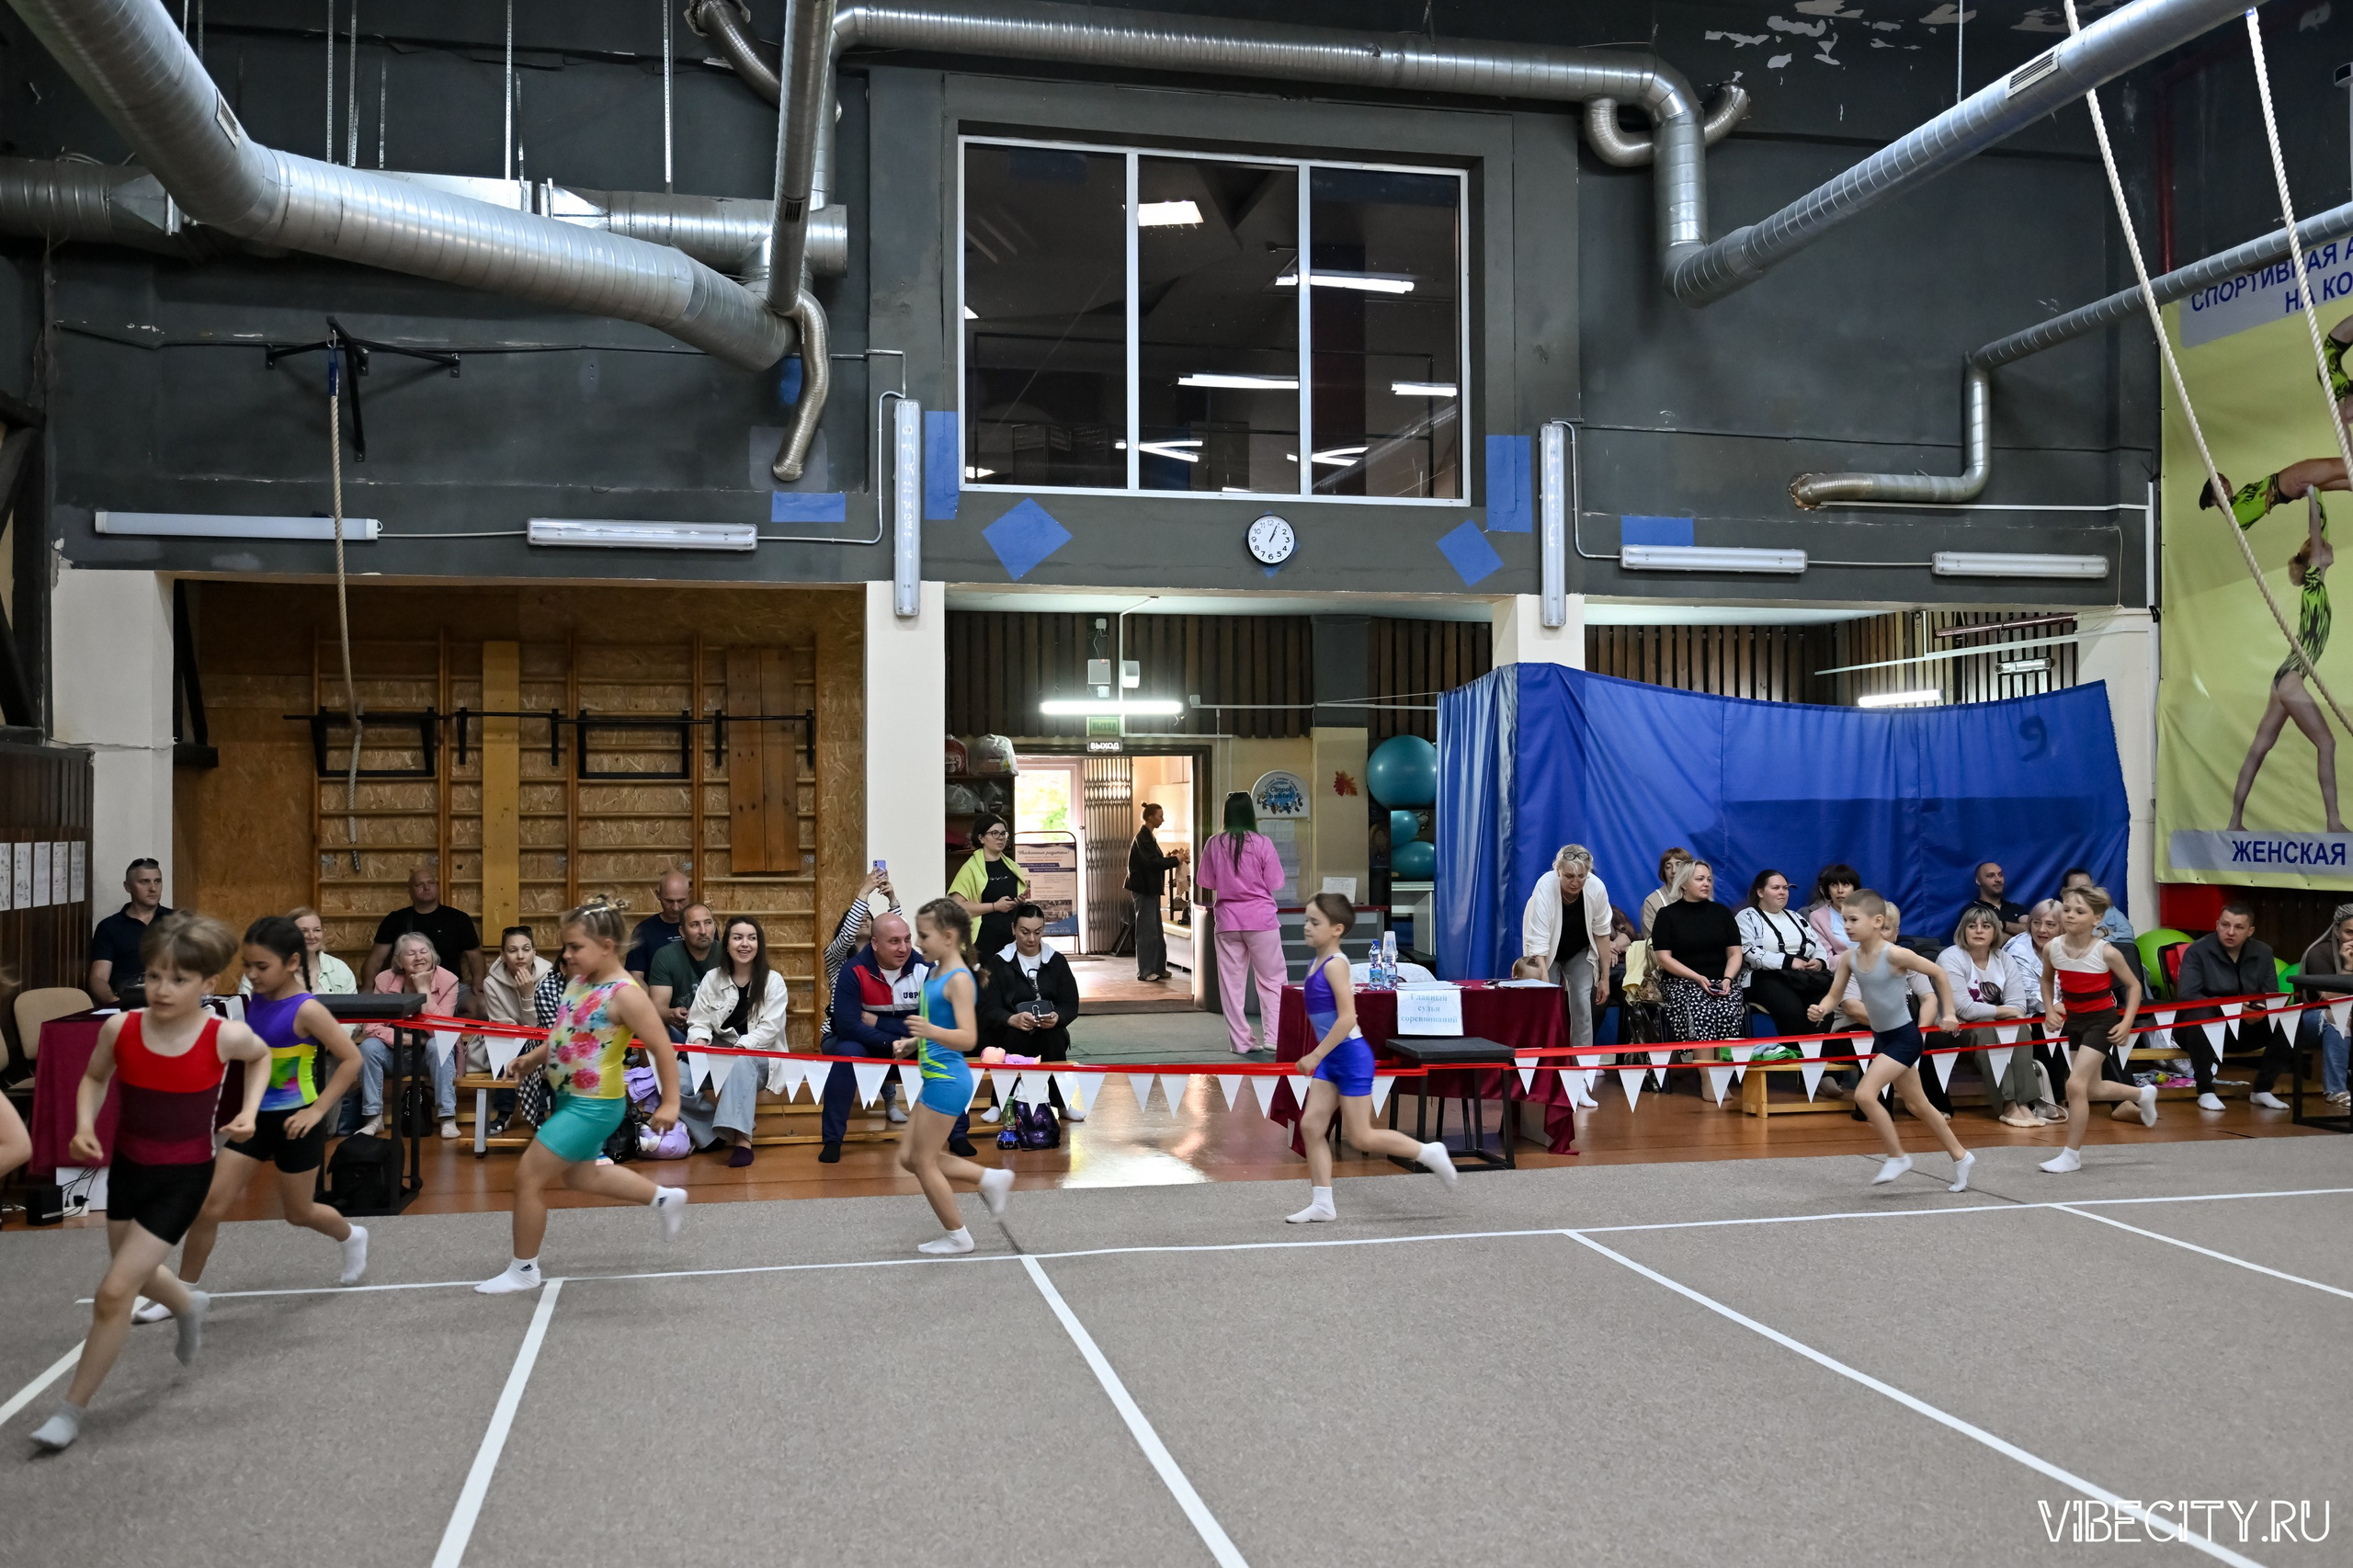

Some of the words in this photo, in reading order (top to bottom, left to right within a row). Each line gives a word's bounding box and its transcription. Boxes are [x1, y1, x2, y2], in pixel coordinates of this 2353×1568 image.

[1090, 742, 1120, 750] ВЫХОД
[2232, 840, 2346, 866] ЖЕНСКАЯ
[1410, 994, 1448, 1002] Главный
[1401, 1016, 1458, 1024] соревнований
